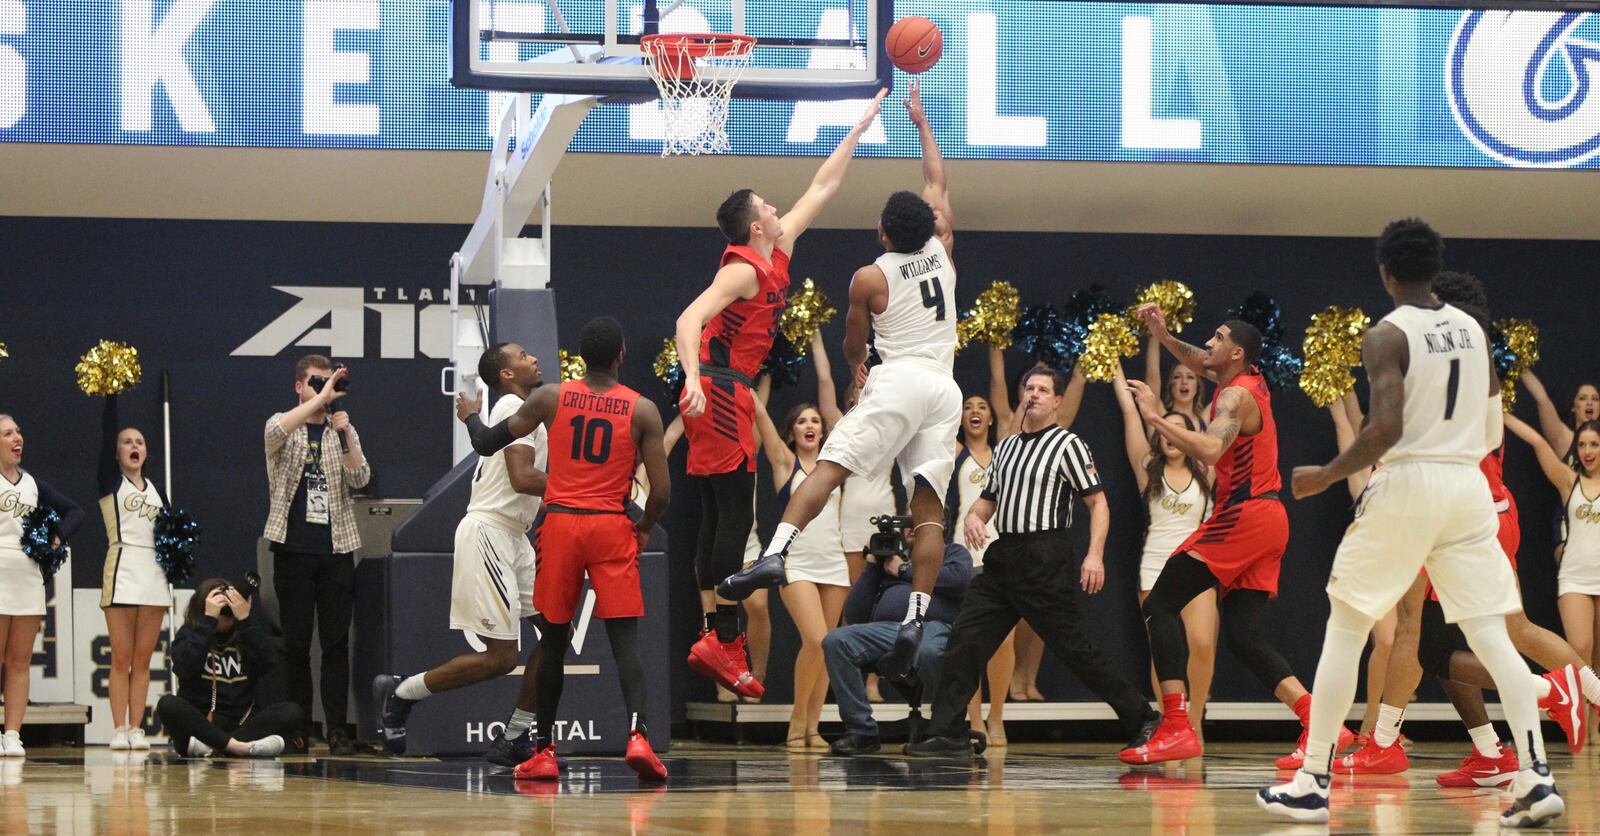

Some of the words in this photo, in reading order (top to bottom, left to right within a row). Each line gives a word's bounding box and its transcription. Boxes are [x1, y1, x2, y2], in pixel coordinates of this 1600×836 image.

[899, 254, 941, 280] WILLIAMS
[919, 276, 945, 321] 4
[1424, 331, 1455, 353] NOLAN
[1444, 358, 1459, 420] 1
[562, 391, 630, 416] CRUTCHER
[570, 414, 613, 464] 10
[204, 652, 242, 678] GW
[466, 719, 602, 742] HOTAL
